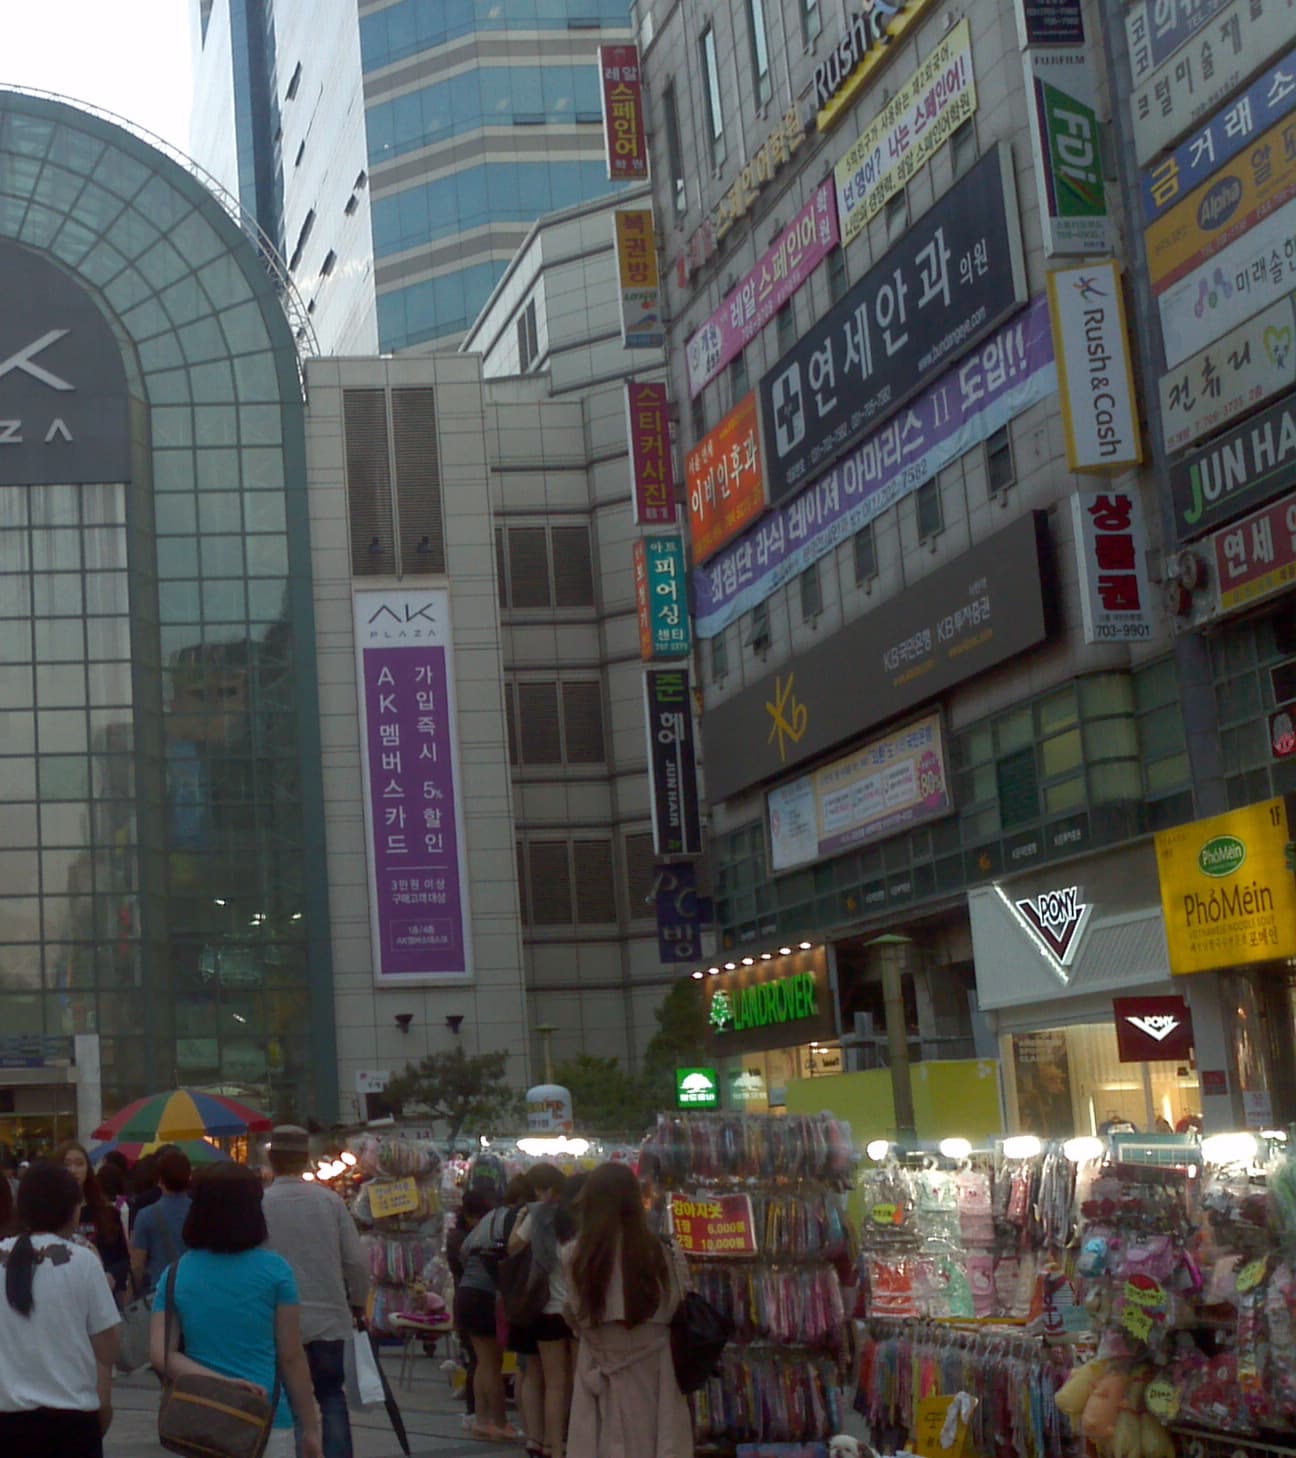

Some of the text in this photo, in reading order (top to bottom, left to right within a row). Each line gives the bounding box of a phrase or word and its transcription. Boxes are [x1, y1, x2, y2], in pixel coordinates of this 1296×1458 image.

[812, 13, 867, 110] Rush
[611, 83, 638, 157] 스페인어
[855, 147, 881, 199] 영어?
[888, 124, 910, 158] 나는
[914, 56, 966, 135] 스페인어!
[1201, 181, 1241, 225] Alpha
[730, 276, 756, 329] 레알
[758, 205, 817, 302] 스페인어
[807, 227, 989, 419] 연세안과 의원
[636, 385, 666, 507] 스티커사진
[691, 427, 758, 521] 이비인후과
[710, 541, 753, 604] 최첨단
[756, 515, 786, 567] 라식
[843, 409, 926, 496] 아마리스
[958, 329, 1030, 412] 도입!!
[1184, 436, 1248, 525] JUN
[367, 602, 436, 624] AK
[654, 556, 680, 625] 피어싱
[370, 629, 437, 639] PLAZA
[883, 627, 932, 673] KB국민은행
[665, 759, 680, 828] JUN HAIR
[423, 807, 444, 853] 할인
[1038, 885, 1079, 928] PONY
[732, 971, 816, 1031] LANDROVER
